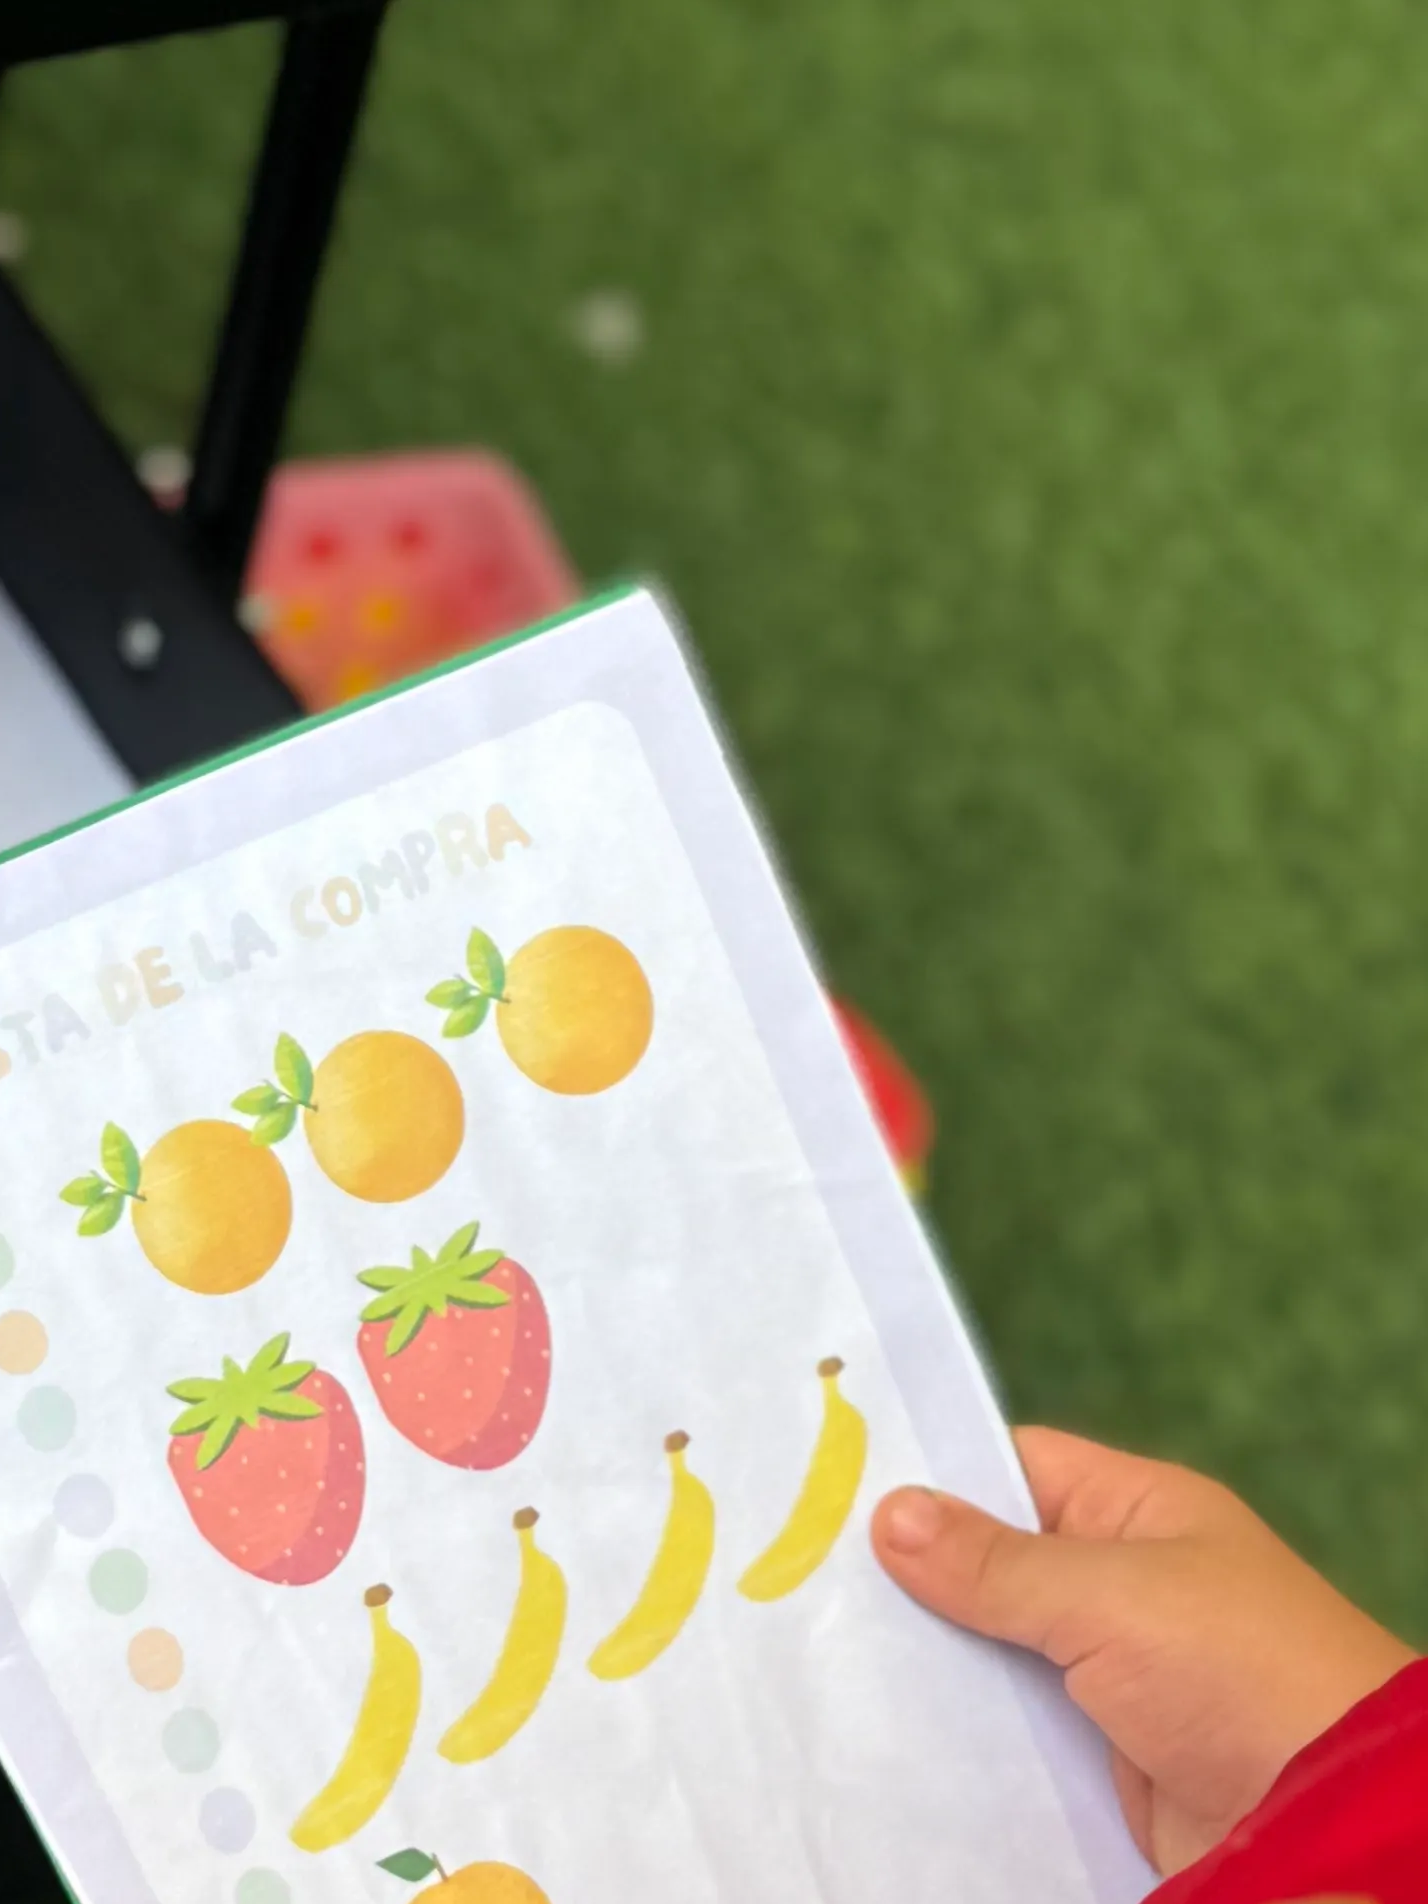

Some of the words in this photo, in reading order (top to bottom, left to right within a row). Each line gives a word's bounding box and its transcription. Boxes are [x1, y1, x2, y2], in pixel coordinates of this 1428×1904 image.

[96, 945, 185, 1026] DE
[189, 911, 278, 983] LA
[290, 802, 533, 938] COMPRA
